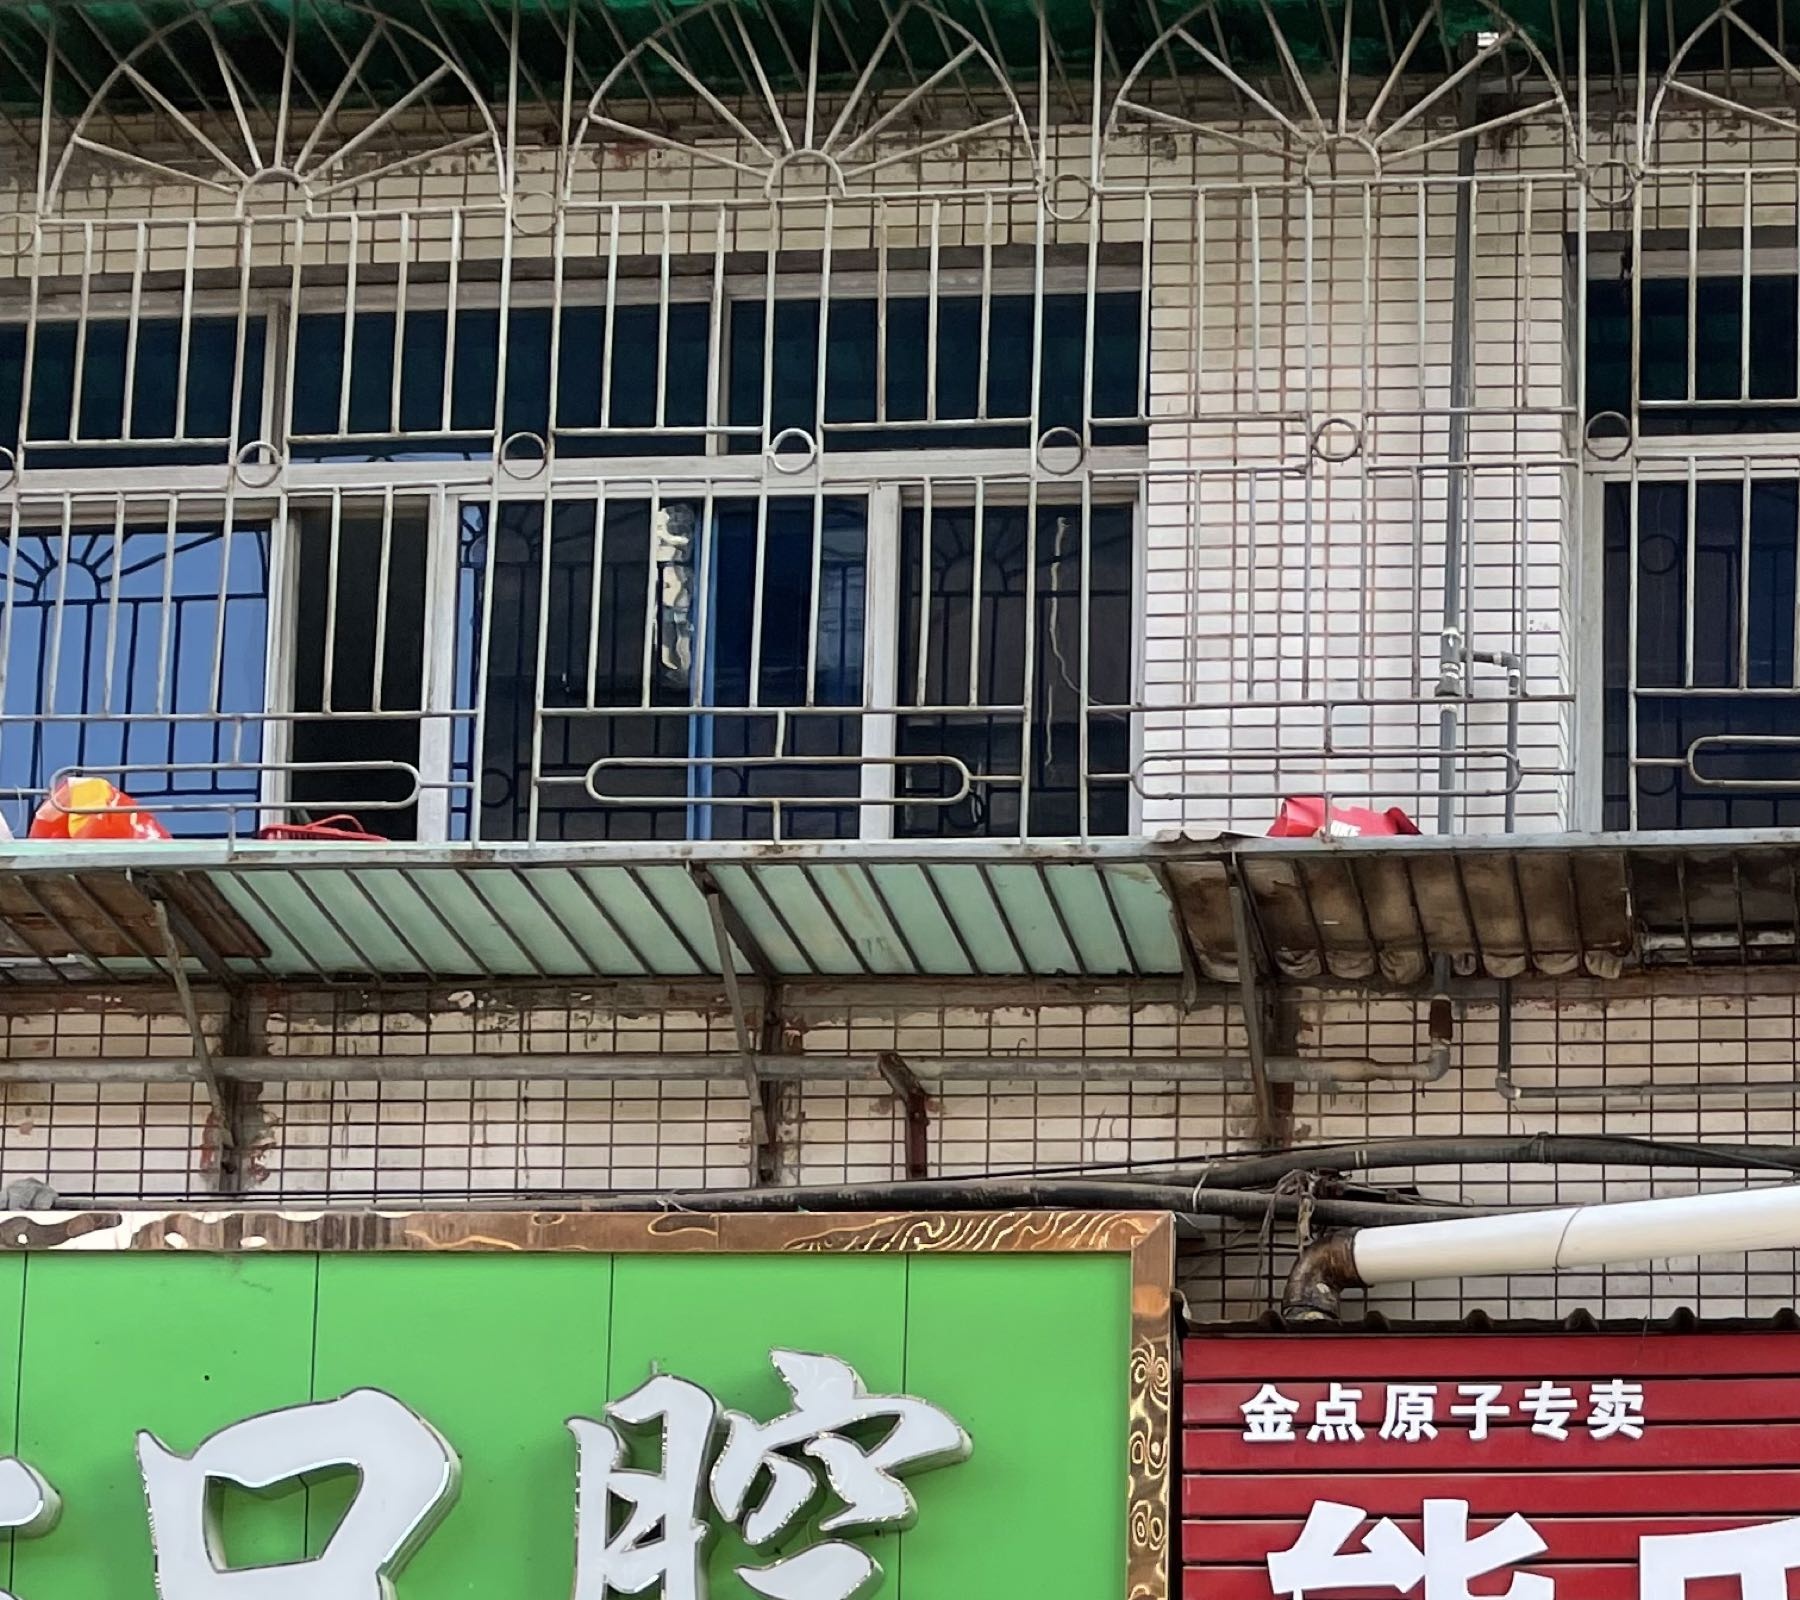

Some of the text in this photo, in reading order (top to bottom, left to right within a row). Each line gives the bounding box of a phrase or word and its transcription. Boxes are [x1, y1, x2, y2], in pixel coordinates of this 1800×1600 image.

[1240, 1379, 1648, 1444] 金点原子专卖
